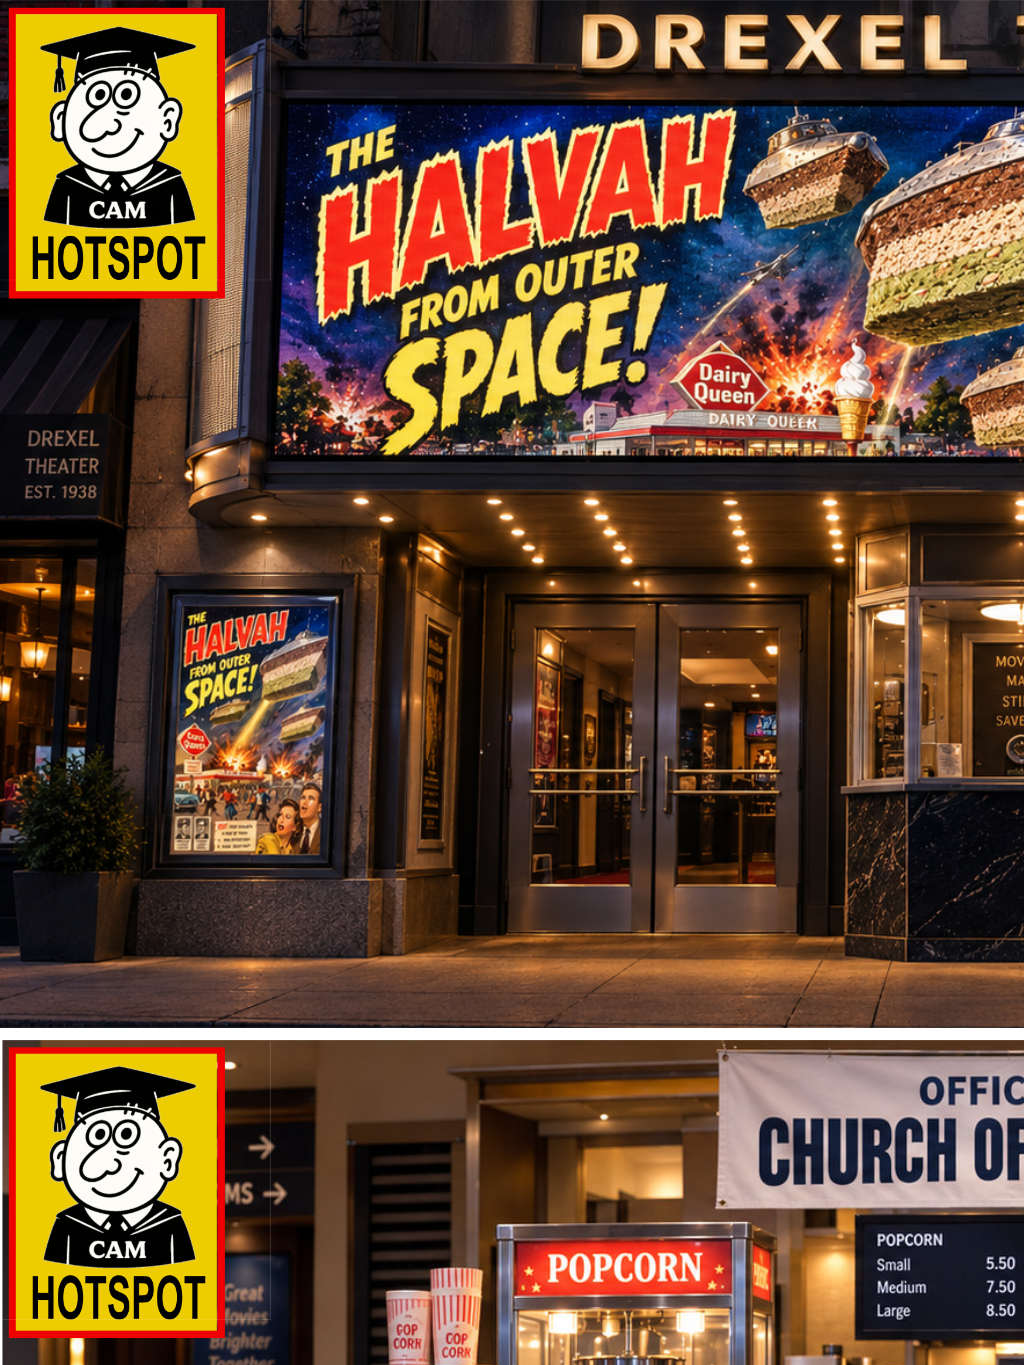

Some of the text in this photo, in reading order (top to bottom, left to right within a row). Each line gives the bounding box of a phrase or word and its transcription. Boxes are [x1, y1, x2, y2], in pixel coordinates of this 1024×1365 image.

[581, 14, 967, 71] DREXEL
[326, 125, 397, 177] THE
[316, 109, 737, 326] HALVAH
[401, 242, 640, 338] FROM OUTER
[381, 282, 669, 456] SPACE!
[699, 363, 751, 388] Dairy
[694, 382, 755, 404] Queen
[27, 429, 100, 447] DREXEL
[24, 458, 100, 474] THEATER
[24, 485, 97, 499] EST. 1938
[758, 1116, 956, 1187] CHURCH
[876, 1233, 943, 1247] POPCORN
[547, 1251, 703, 1283] POPCORN
[876, 1256, 1015, 1272] Small 5.50
[876, 1280, 1015, 1294] Medium 7.50
[876, 1303, 1015, 1320] Large 8.50
